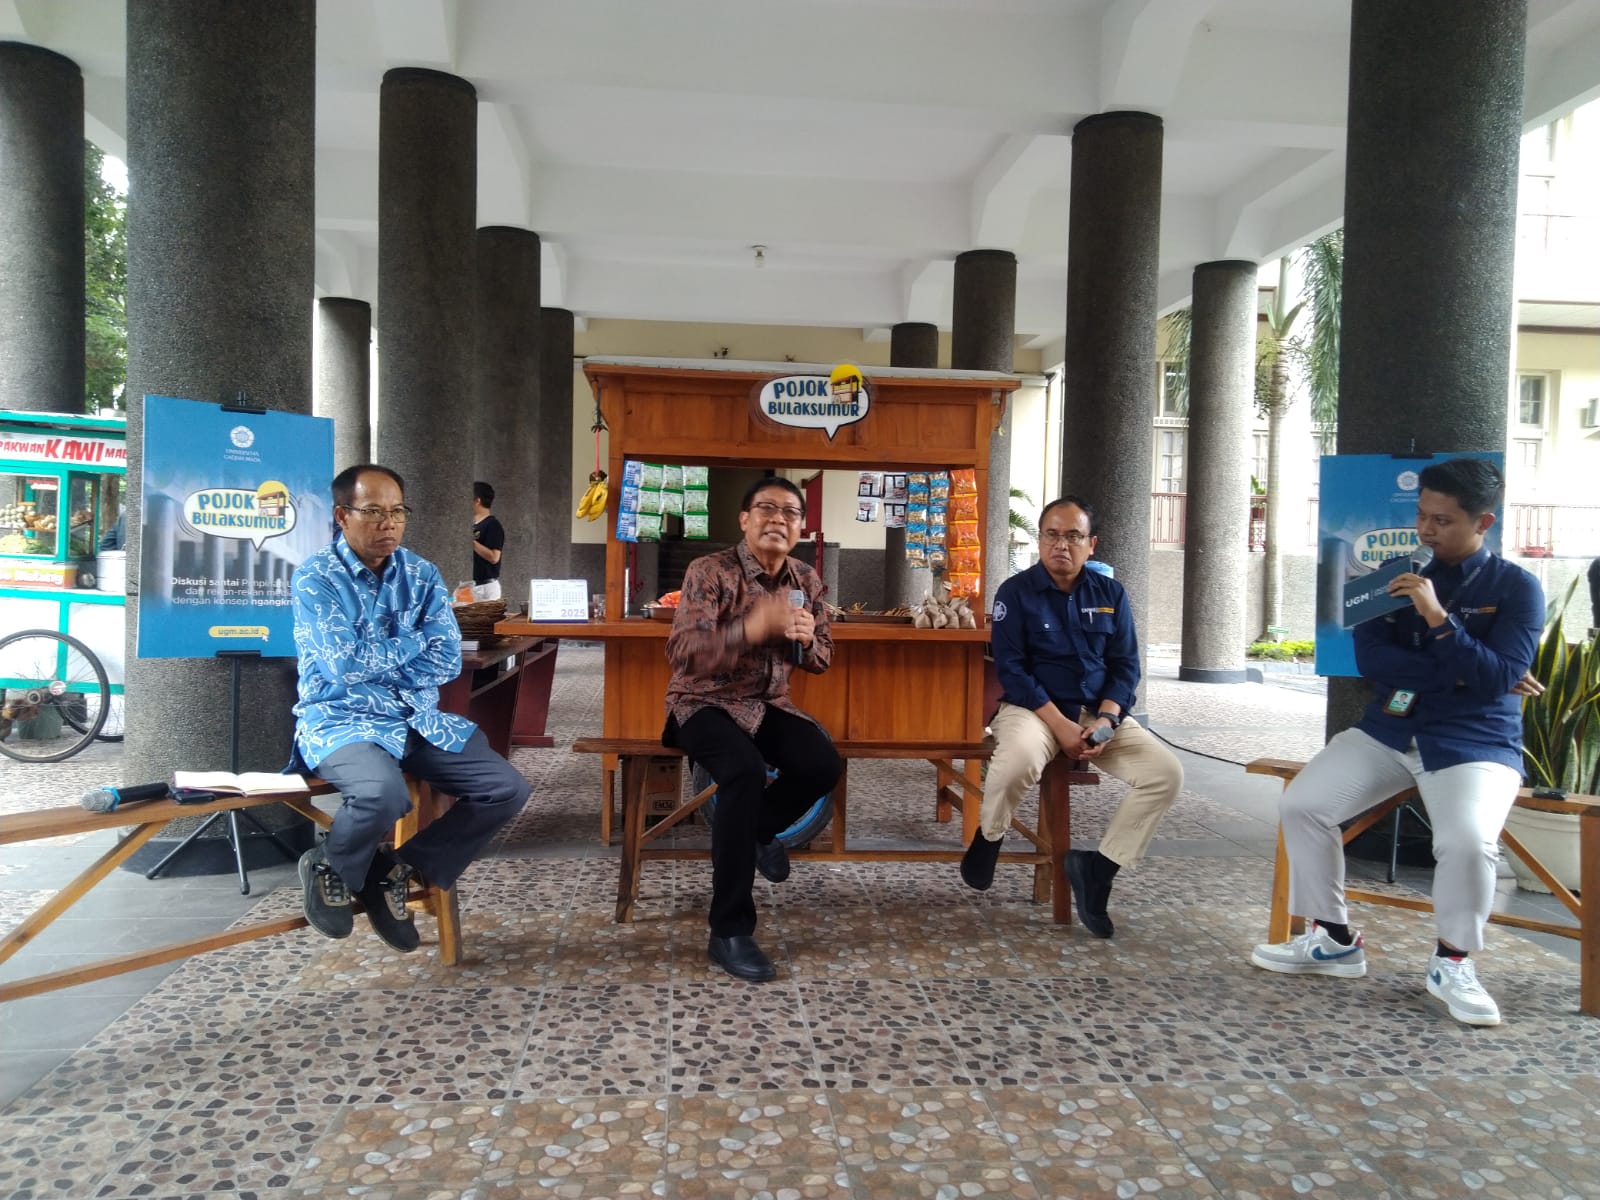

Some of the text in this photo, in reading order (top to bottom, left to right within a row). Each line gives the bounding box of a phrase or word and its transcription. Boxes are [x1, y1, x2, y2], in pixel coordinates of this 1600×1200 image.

[773, 380, 828, 399] POJOK
[45, 439, 105, 462] KAWI
[198, 493, 256, 510] POJOK
[1366, 531, 1419, 549] POJOK
[171, 577, 206, 586] Diskusi
[209, 578, 239, 587] santai
[1345, 592, 1369, 608] UGM
[561, 608, 585, 618] 2025
